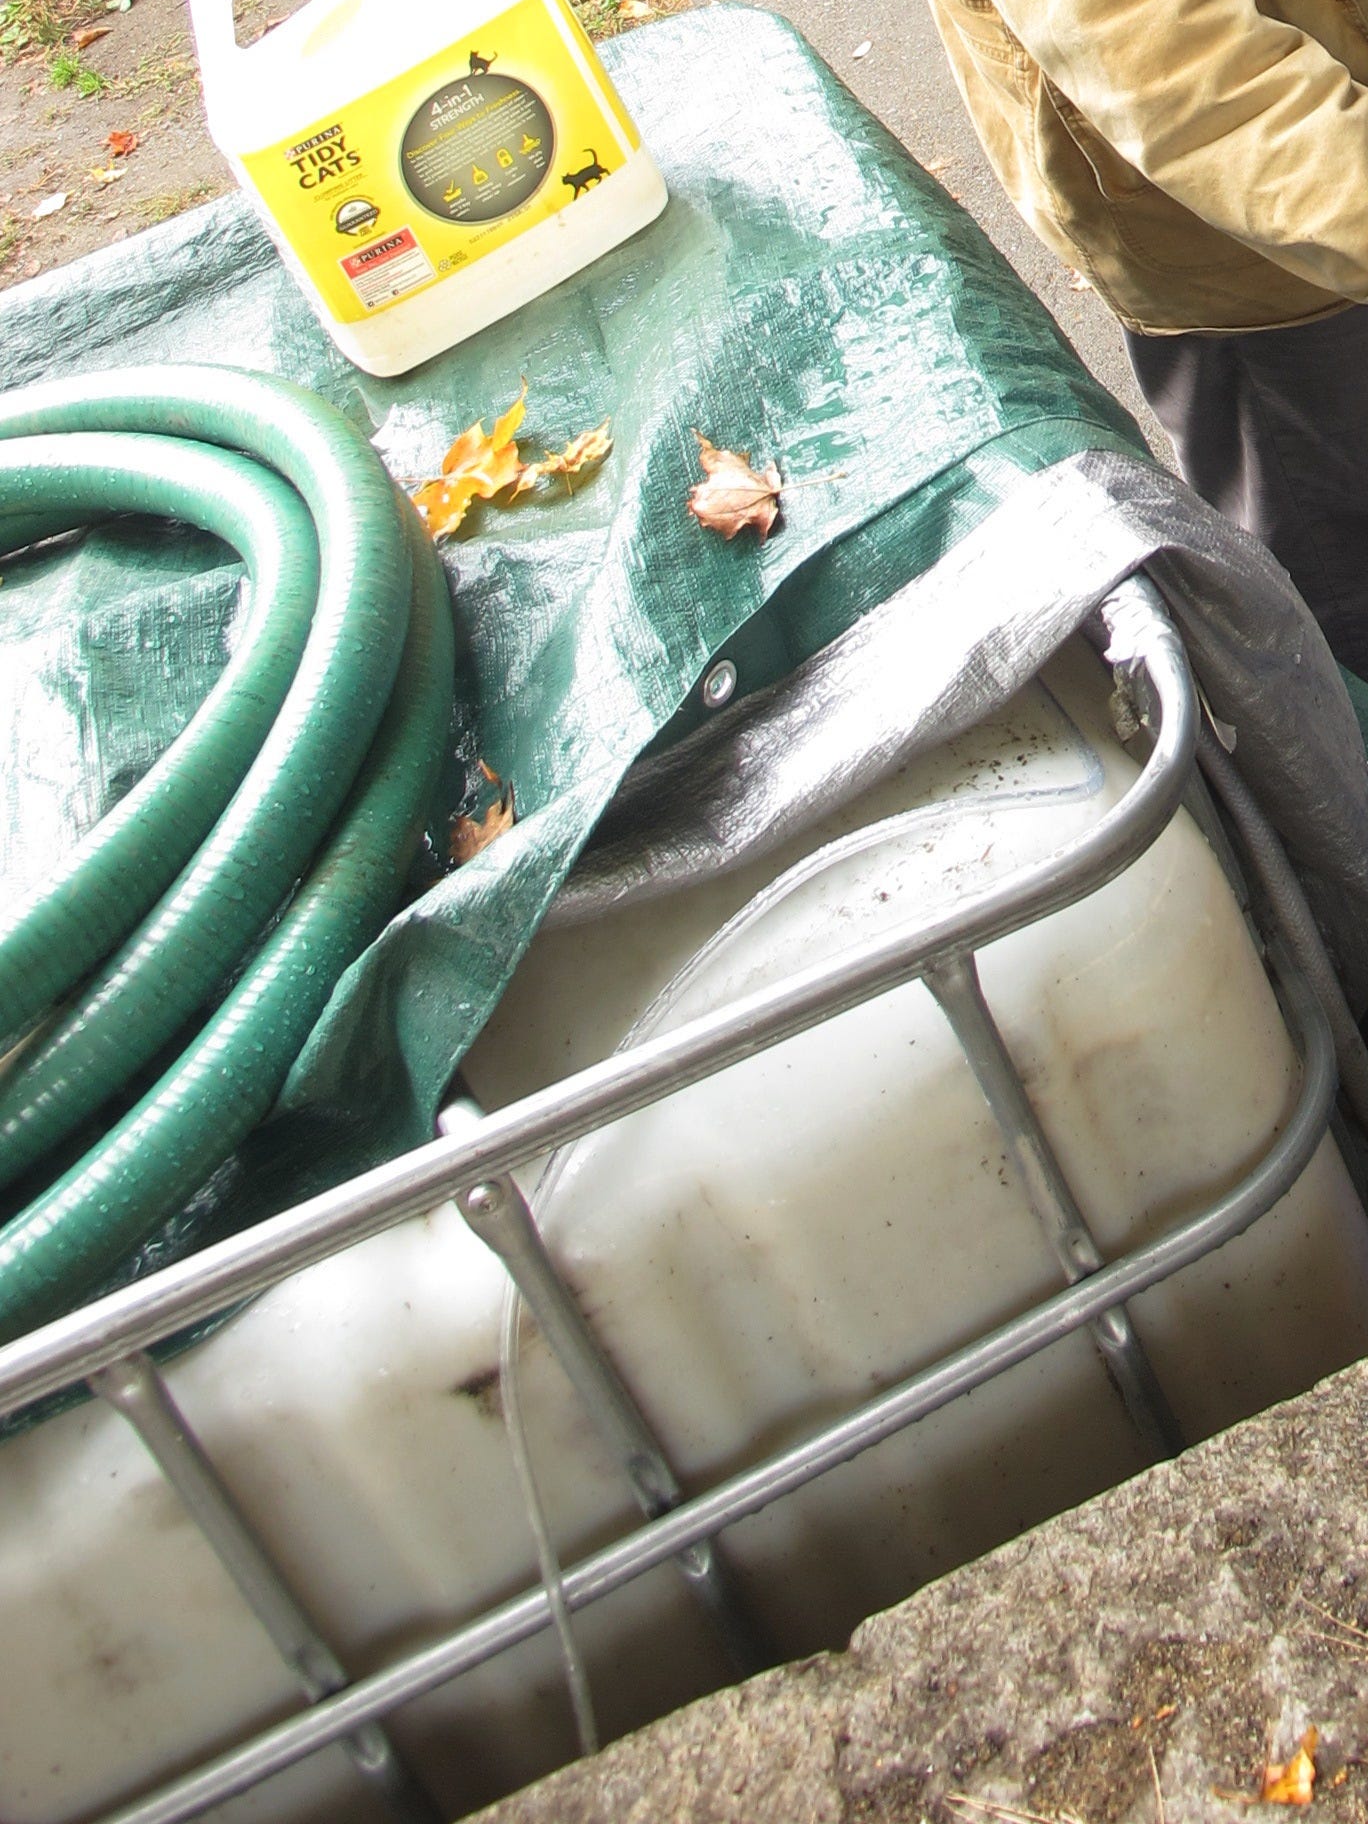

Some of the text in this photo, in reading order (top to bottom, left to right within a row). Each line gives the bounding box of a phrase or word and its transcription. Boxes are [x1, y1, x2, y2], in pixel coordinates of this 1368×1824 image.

[430, 93, 485, 131] STRENGTH
[431, 84, 473, 116] 4-in-1
[290, 135, 346, 174] TIDY
[294, 124, 342, 155] PURINA
[299, 150, 361, 189] CATS
[360, 236, 404, 263] PURINA
